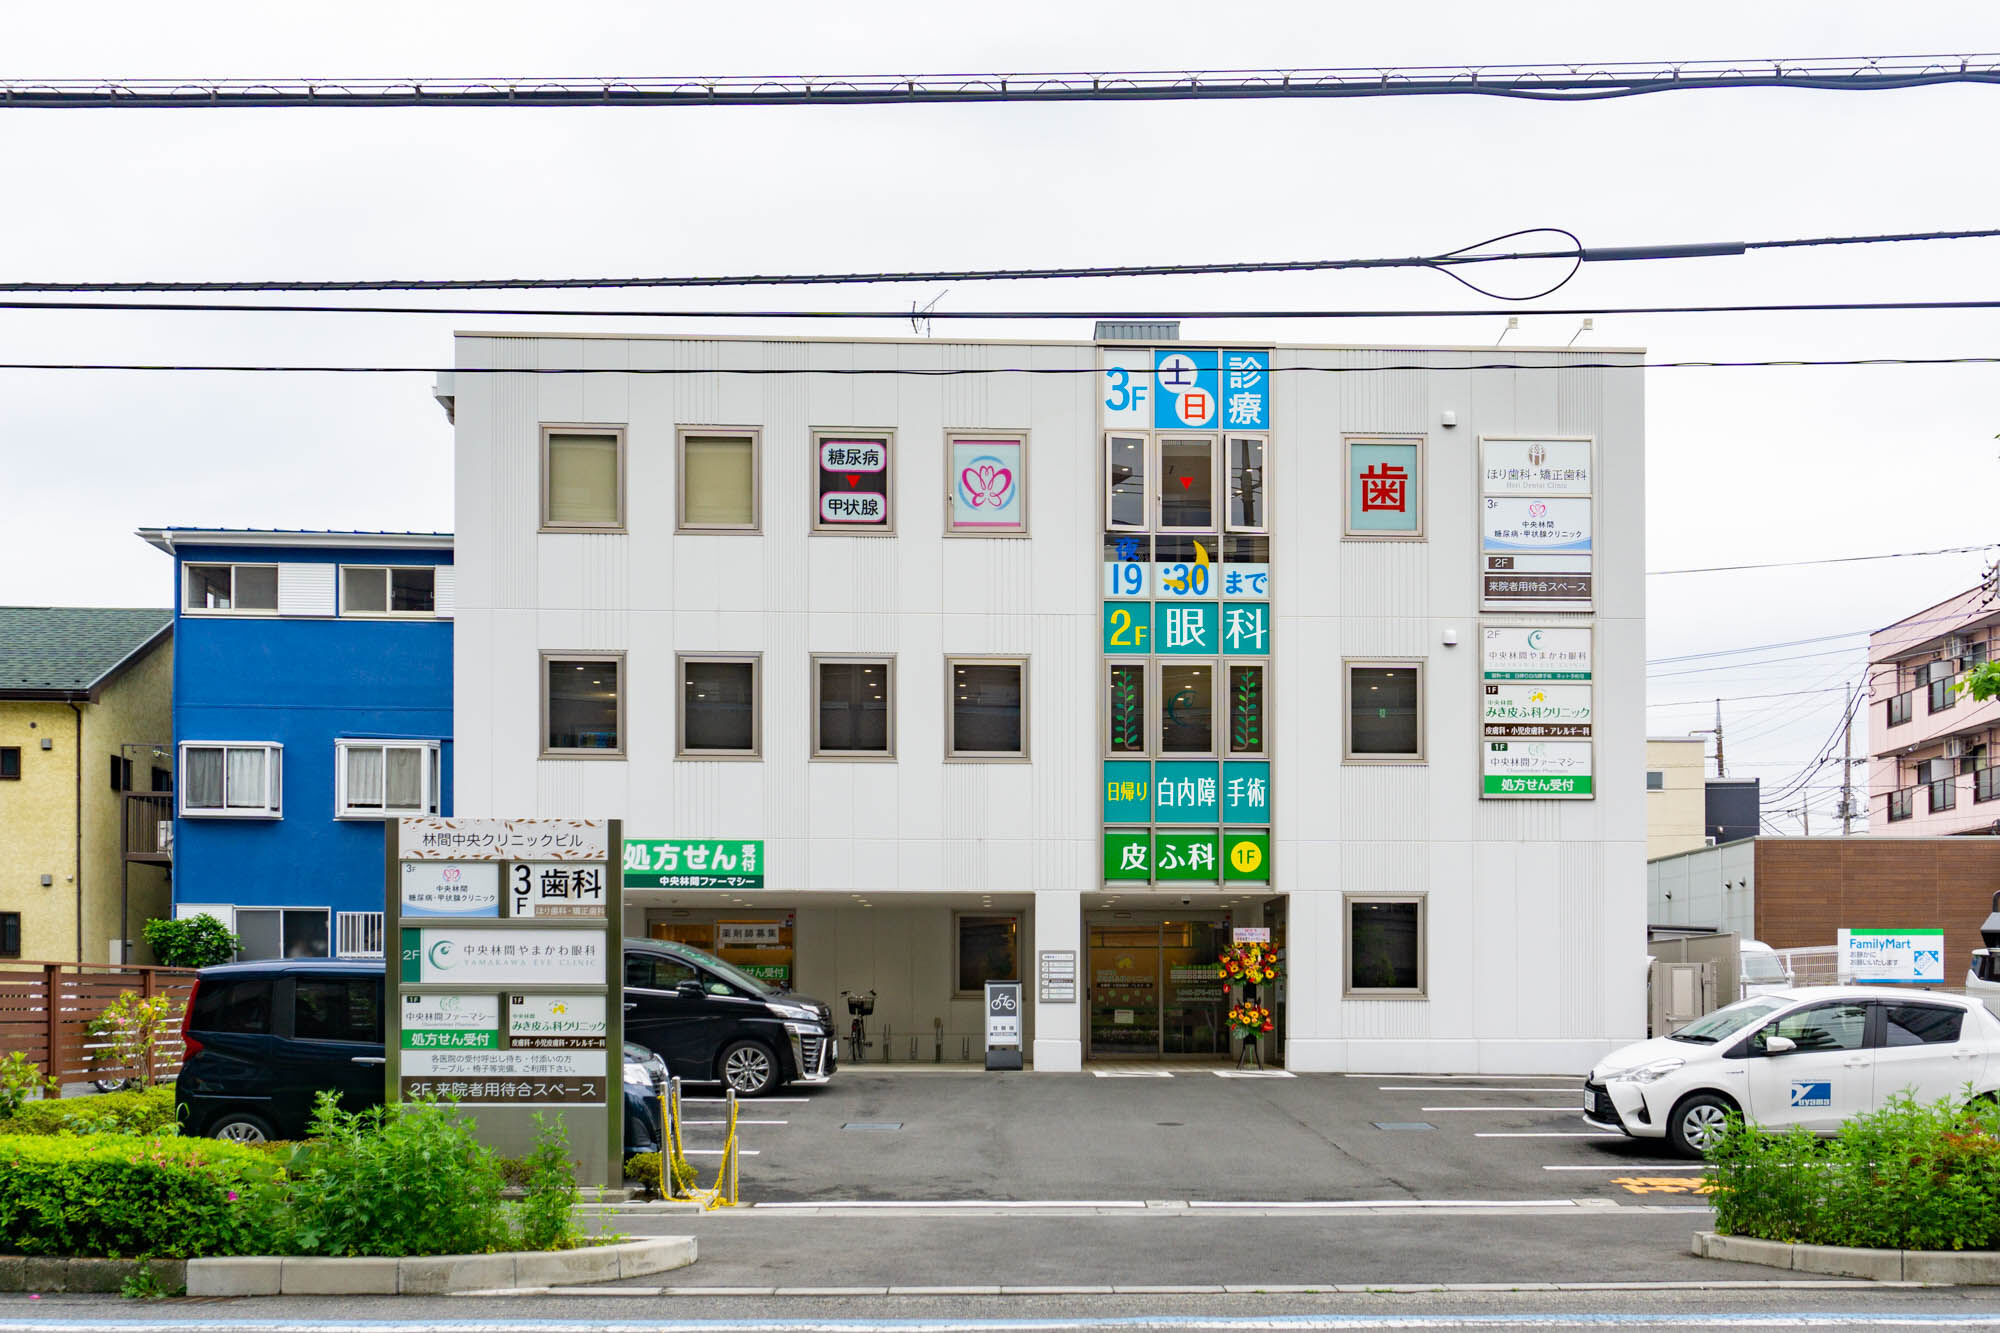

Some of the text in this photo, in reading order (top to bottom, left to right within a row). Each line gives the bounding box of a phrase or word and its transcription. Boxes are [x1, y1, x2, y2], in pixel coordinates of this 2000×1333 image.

[1105, 366, 1148, 411] 3F
[1228, 356, 1262, 425] 診療
[827, 449, 879, 466] 糖尿病
[1359, 462, 1408, 512] 歯
[828, 498, 879, 515] 甲状腺
[1487, 499, 1499, 509] 3F
[1114, 536, 1140, 561] 夜
[1495, 558, 1508, 568] 2F
[1488, 581, 1587, 592] 来院者用待合スペース
[1110, 608, 1267, 649] 2F 眼科
[1487, 630, 1501, 639] 2F
[1487, 686, 1497, 694] 1F
[1485, 707, 1590, 719] みき皮ふ科クリニック
[1495, 743, 1505, 751] 1F
[1501, 778, 1575, 791] 処方せん受付
[422, 832, 583, 848] 林間中央クリニックビル
[1119, 842, 1255, 871] 皮ふ科 1F
[406, 864, 416, 873] 3F
[540, 868, 602, 899] 歯科
[659, 875, 756, 887] 中央林間ファーマシー
[435, 885, 468, 893] 中央林間
[463, 945, 596, 956] 中央林間やまかわ眼科
[1849, 938, 1911, 952] FamilyMart
[403, 950, 420, 961] 2F
[512, 1021, 606, 1032] みき皮ふ科クリニック
[411, 1032, 490, 1047] 処方せん受付
[410, 1082, 597, 1097] 2F 来院者用待合スペース
